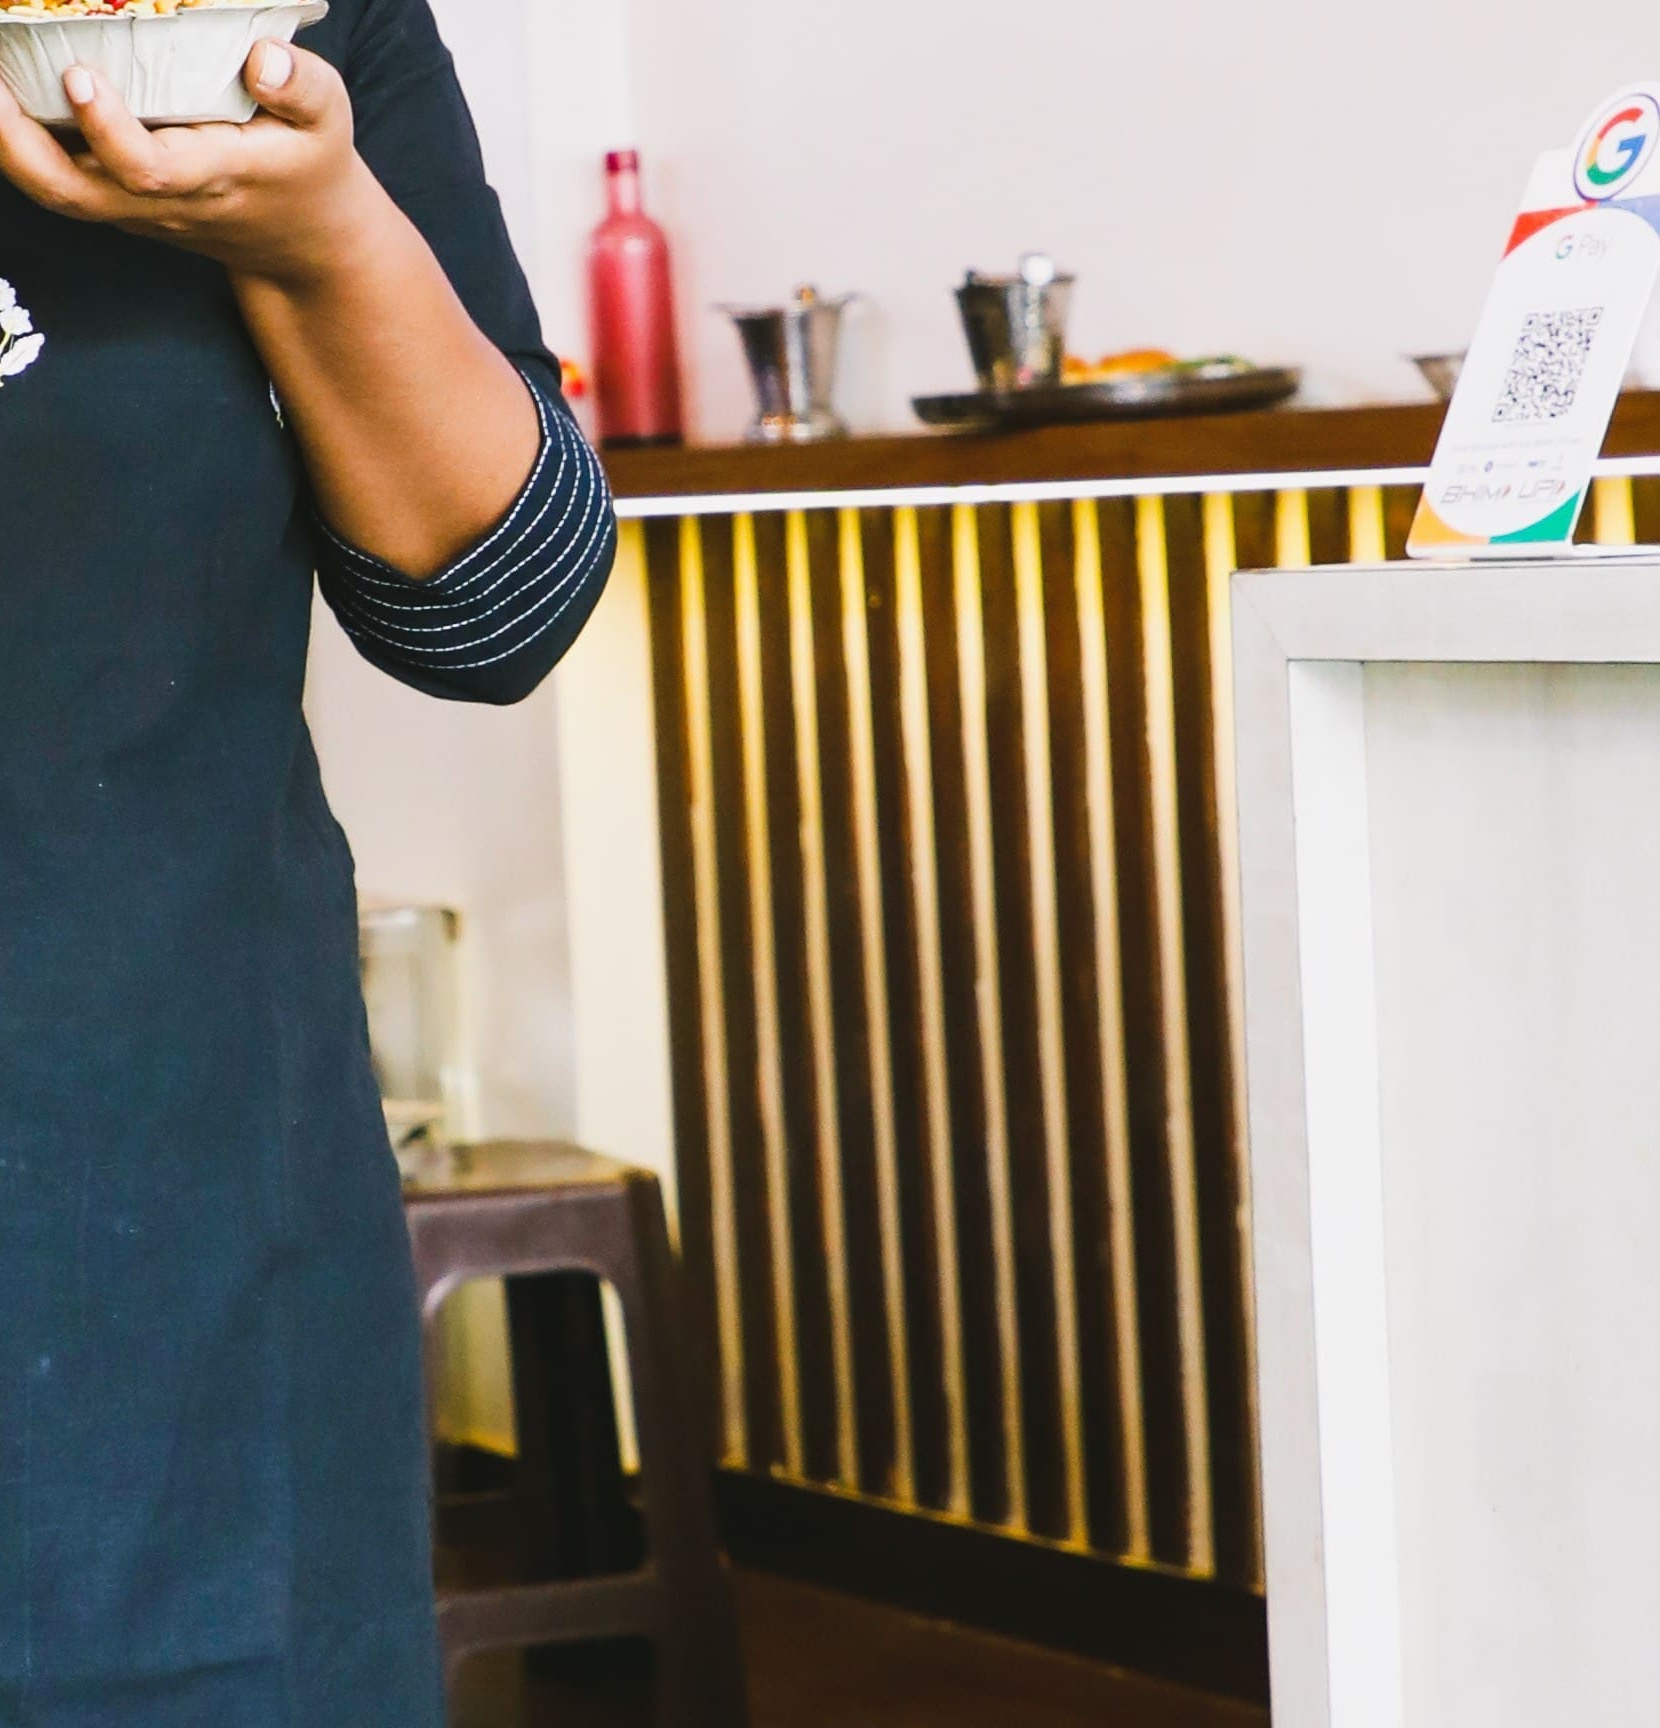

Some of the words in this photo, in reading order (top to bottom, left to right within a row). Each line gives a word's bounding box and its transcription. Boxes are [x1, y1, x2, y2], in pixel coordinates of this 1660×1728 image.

[1586, 107, 1646, 186] G
[1577, 232, 1613, 265] Pay
[1440, 482, 1503, 505] BHIM
